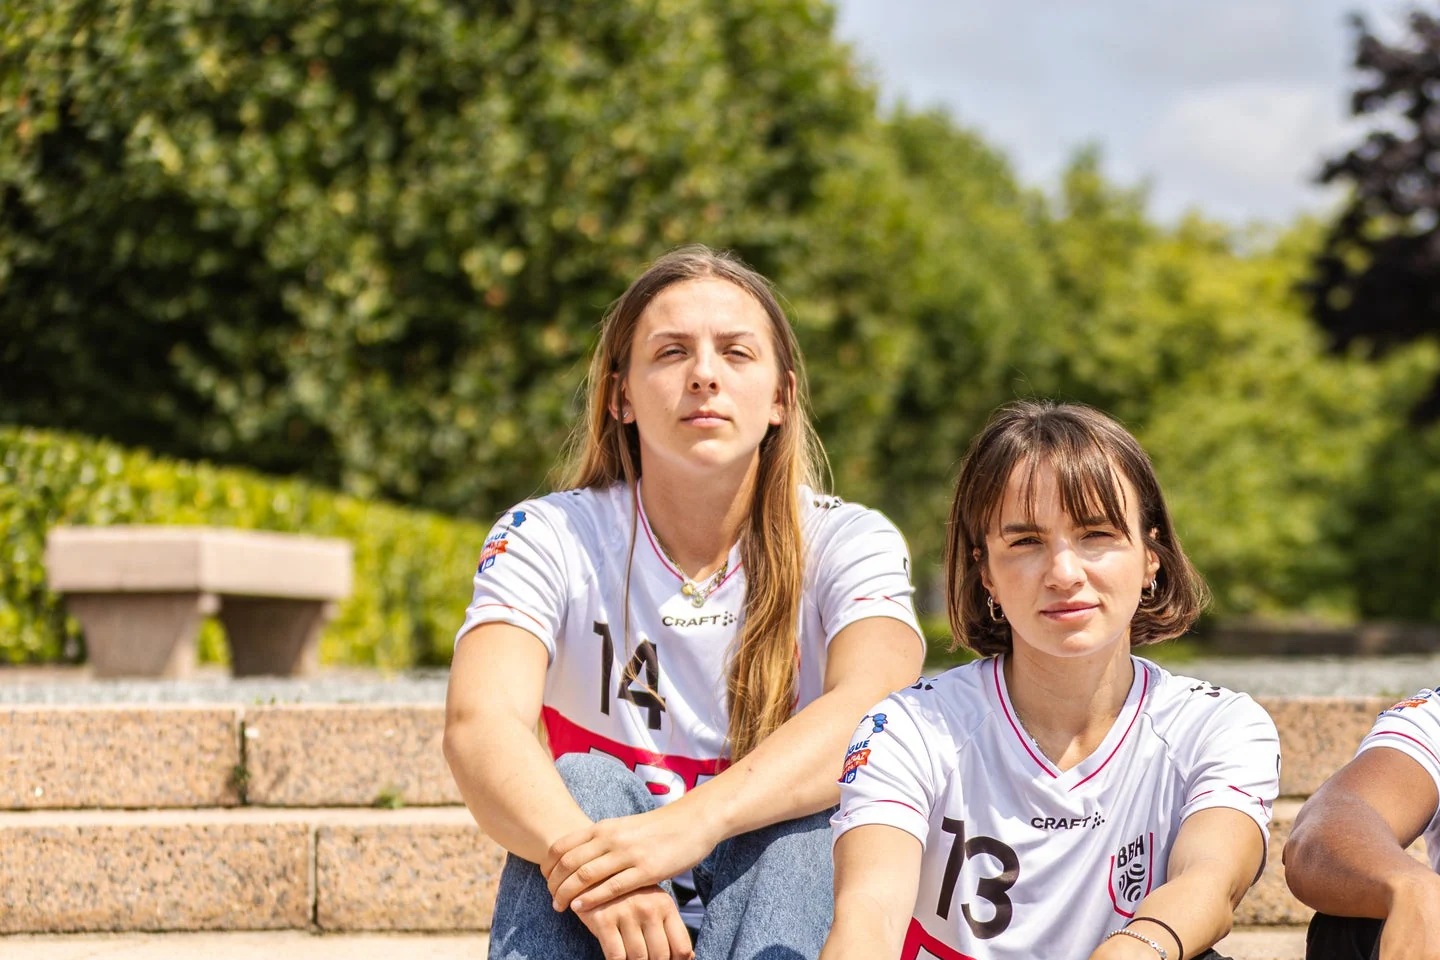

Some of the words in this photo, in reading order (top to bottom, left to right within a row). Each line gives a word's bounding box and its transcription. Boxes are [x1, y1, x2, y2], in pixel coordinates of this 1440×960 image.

[662, 614, 721, 627] CRAFT
[593, 621, 666, 731] 14
[1030, 816, 1091, 830] CRAFT
[1117, 834, 1144, 868] BBH
[936, 816, 1020, 939] 13
